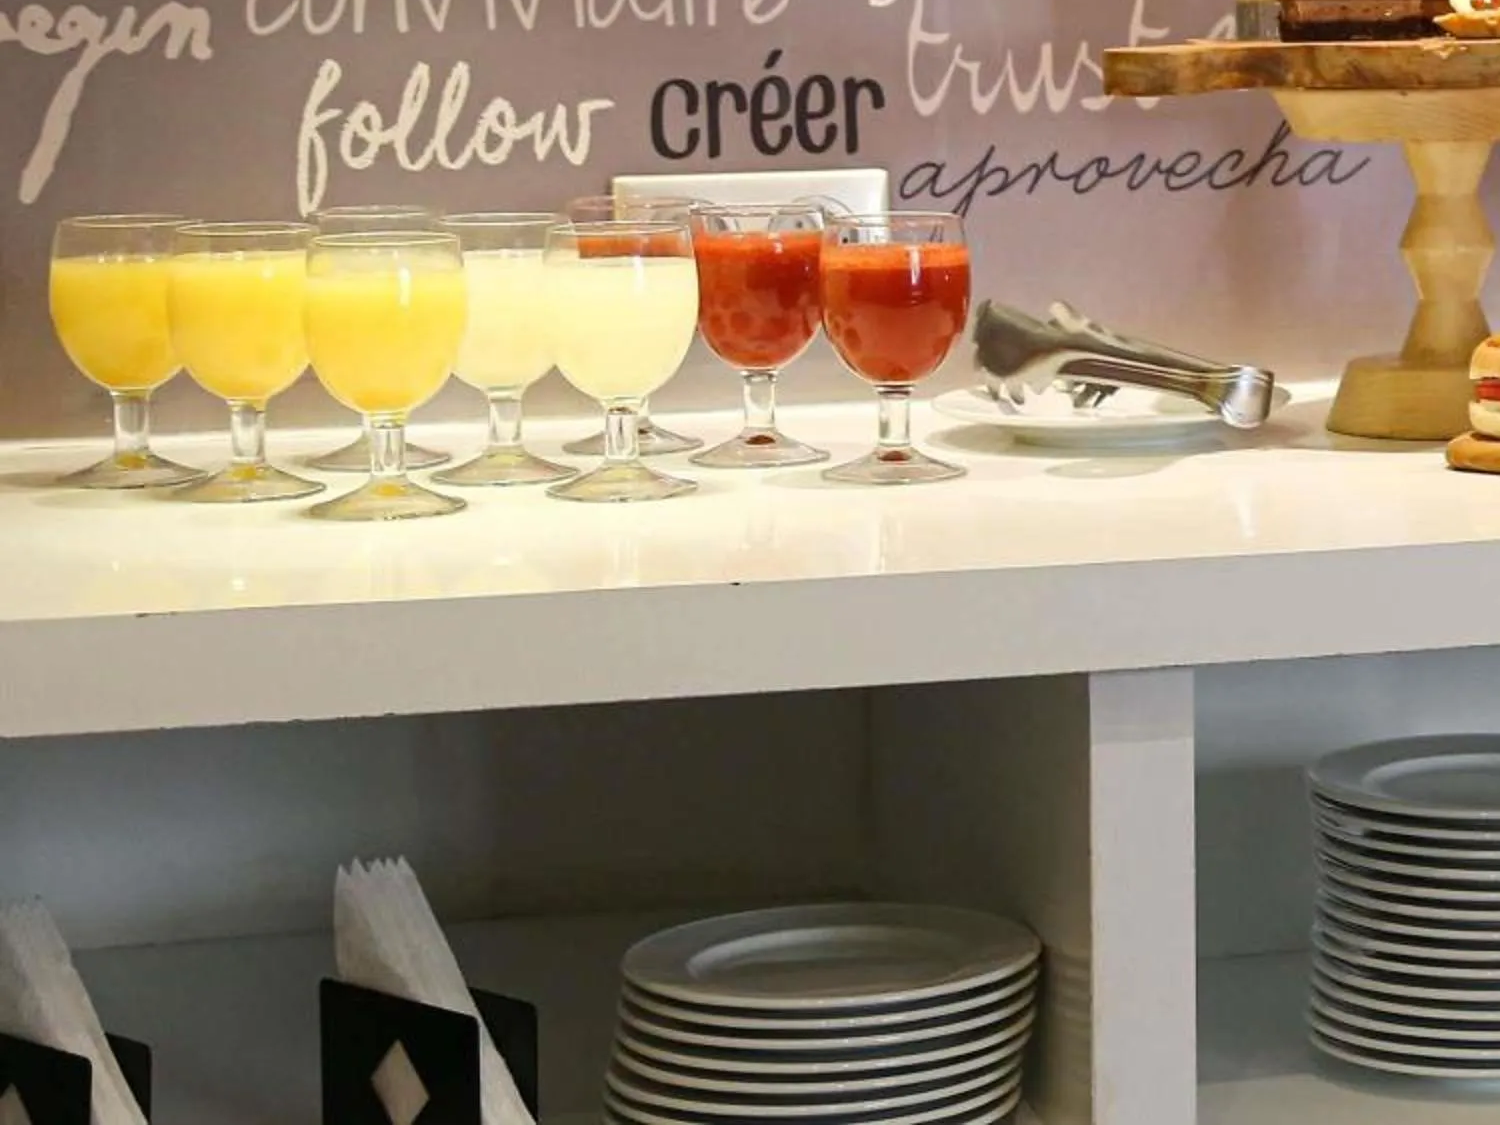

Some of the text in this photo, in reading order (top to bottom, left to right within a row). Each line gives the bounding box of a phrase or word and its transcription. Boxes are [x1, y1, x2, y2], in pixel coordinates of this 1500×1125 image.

[296, 59, 615, 217] follow
[649, 49, 886, 159] créer
[900, 119, 1371, 241] aprovecha
